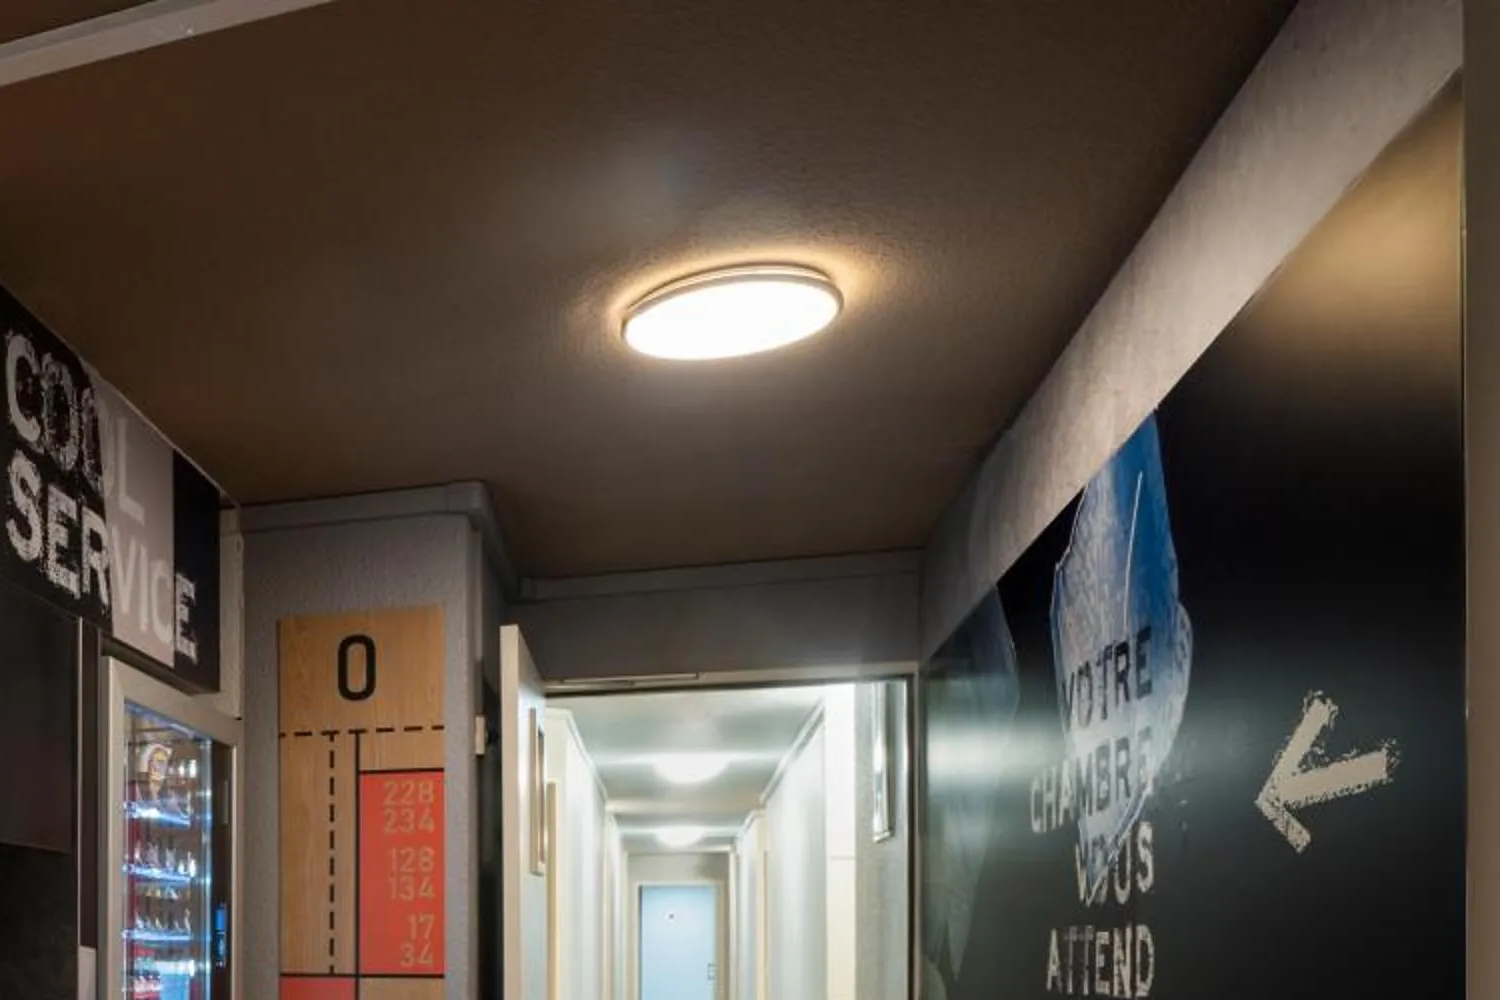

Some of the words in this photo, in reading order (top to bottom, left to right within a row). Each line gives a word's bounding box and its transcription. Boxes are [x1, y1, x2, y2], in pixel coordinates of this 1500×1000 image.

[5, 328, 145, 527] COOL
[5, 448, 198, 665] SERVICE
[1062, 625, 1154, 734] VOTRE
[383, 780, 436, 805] 228
[1030, 726, 1154, 834] CHAMBRE
[383, 806, 436, 834] 234
[388, 847, 436, 873] 128
[1075, 820, 1155, 907] VOUS
[388, 874, 436, 901] 134
[408, 912, 436, 941] 17
[401, 942, 435, 968] 34
[1046, 923, 1156, 999] ATTEND
